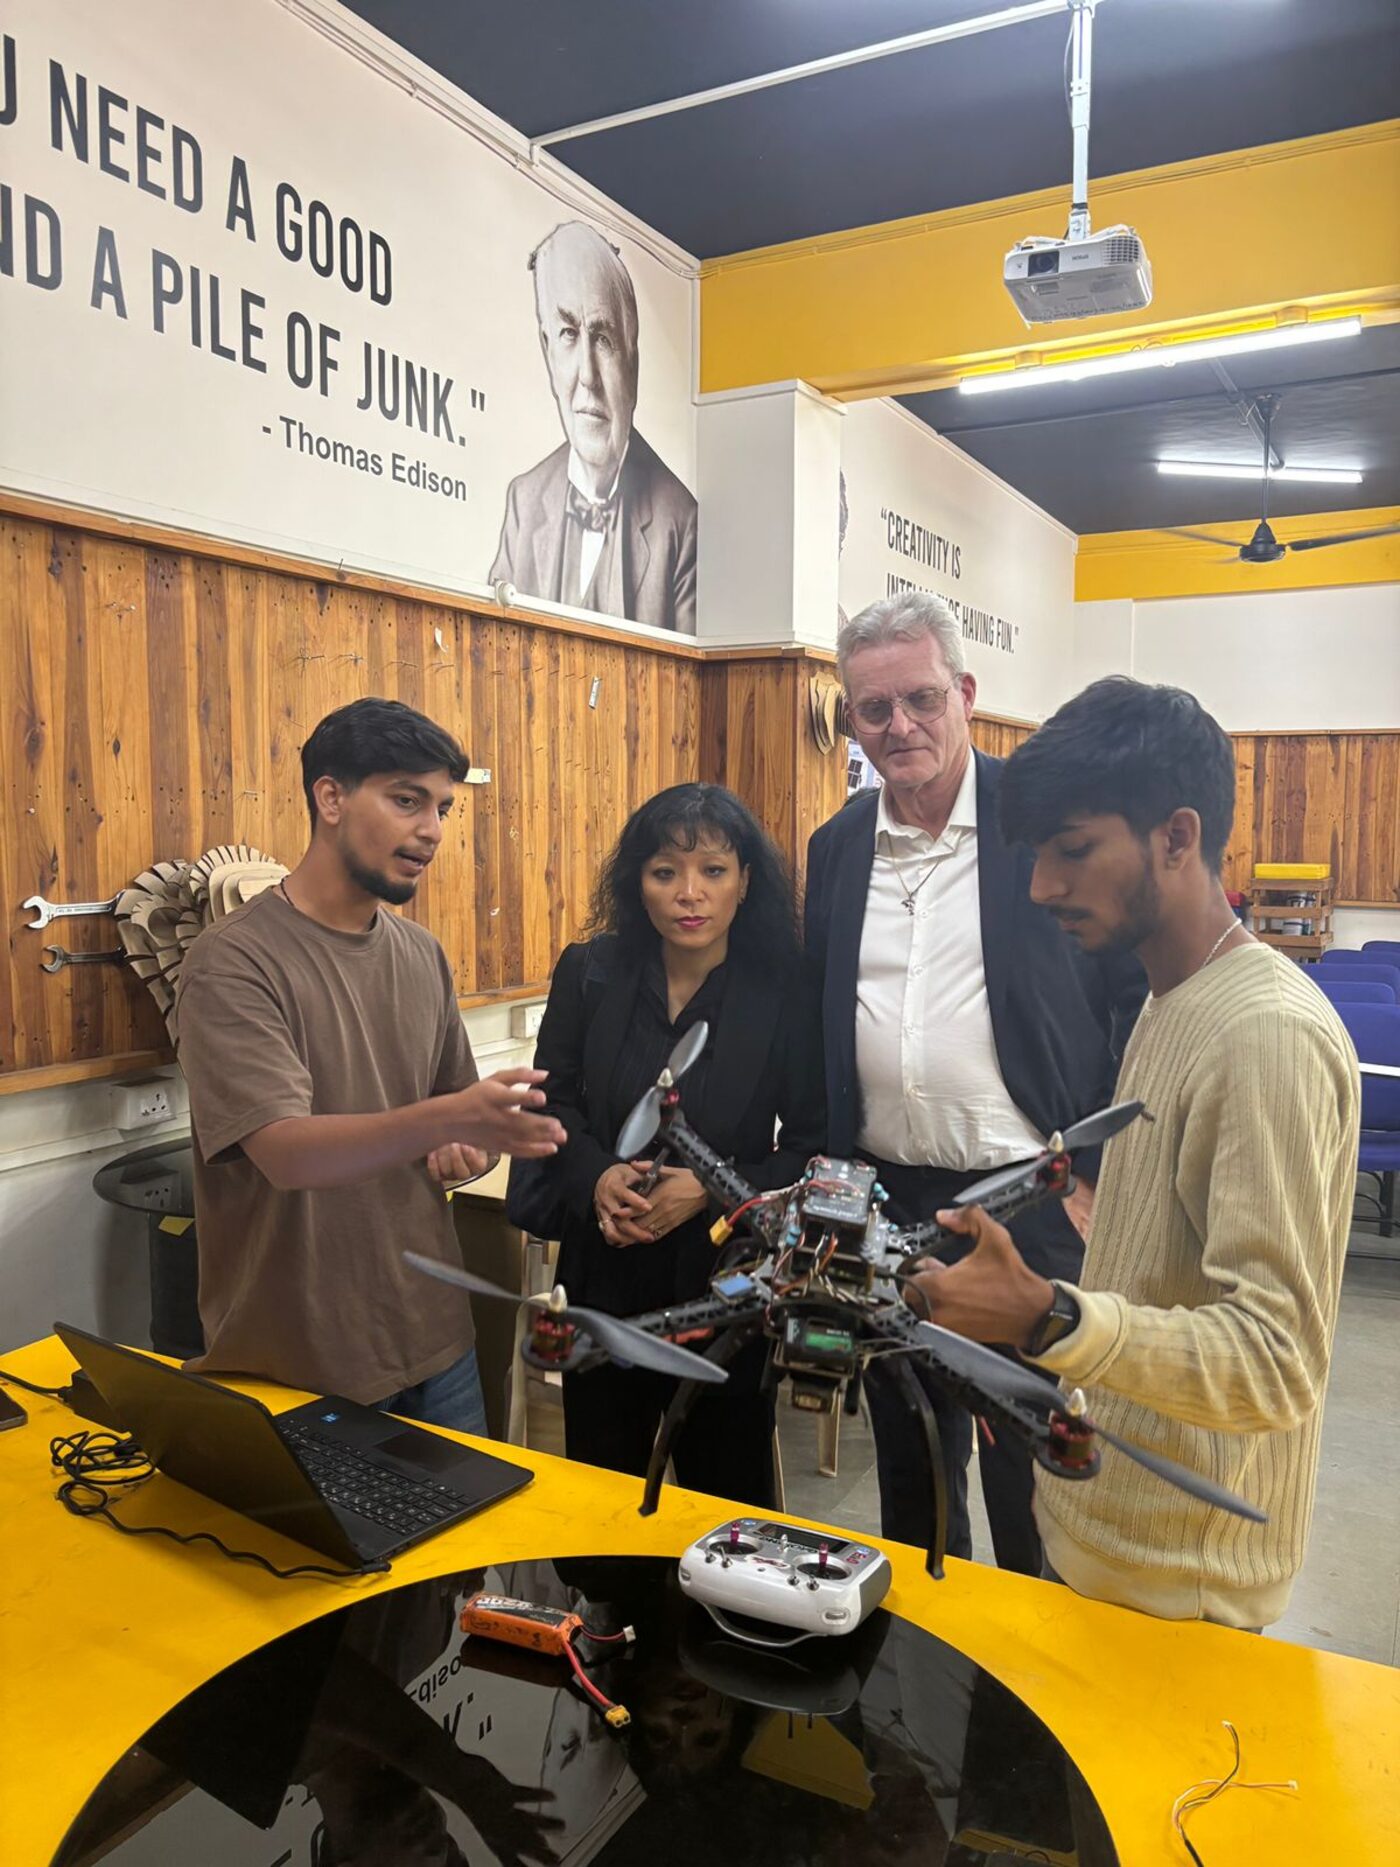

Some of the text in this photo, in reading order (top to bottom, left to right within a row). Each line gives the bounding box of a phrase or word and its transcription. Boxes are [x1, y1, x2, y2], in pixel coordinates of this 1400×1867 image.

[49, 58, 203, 214] NEED
[225, 155, 256, 243] A
[276, 182, 392, 306] GOOD
[90, 225, 128, 320] A
[152, 248, 267, 374] PILE
[286, 311, 341, 398] OF
[357, 341, 486, 447] JUNK."
[279, 415, 383, 476] Thomas
[391, 453, 467, 501] Edison
[952, 543, 961, 580] IS
[962, 605, 994, 647] HAVING
